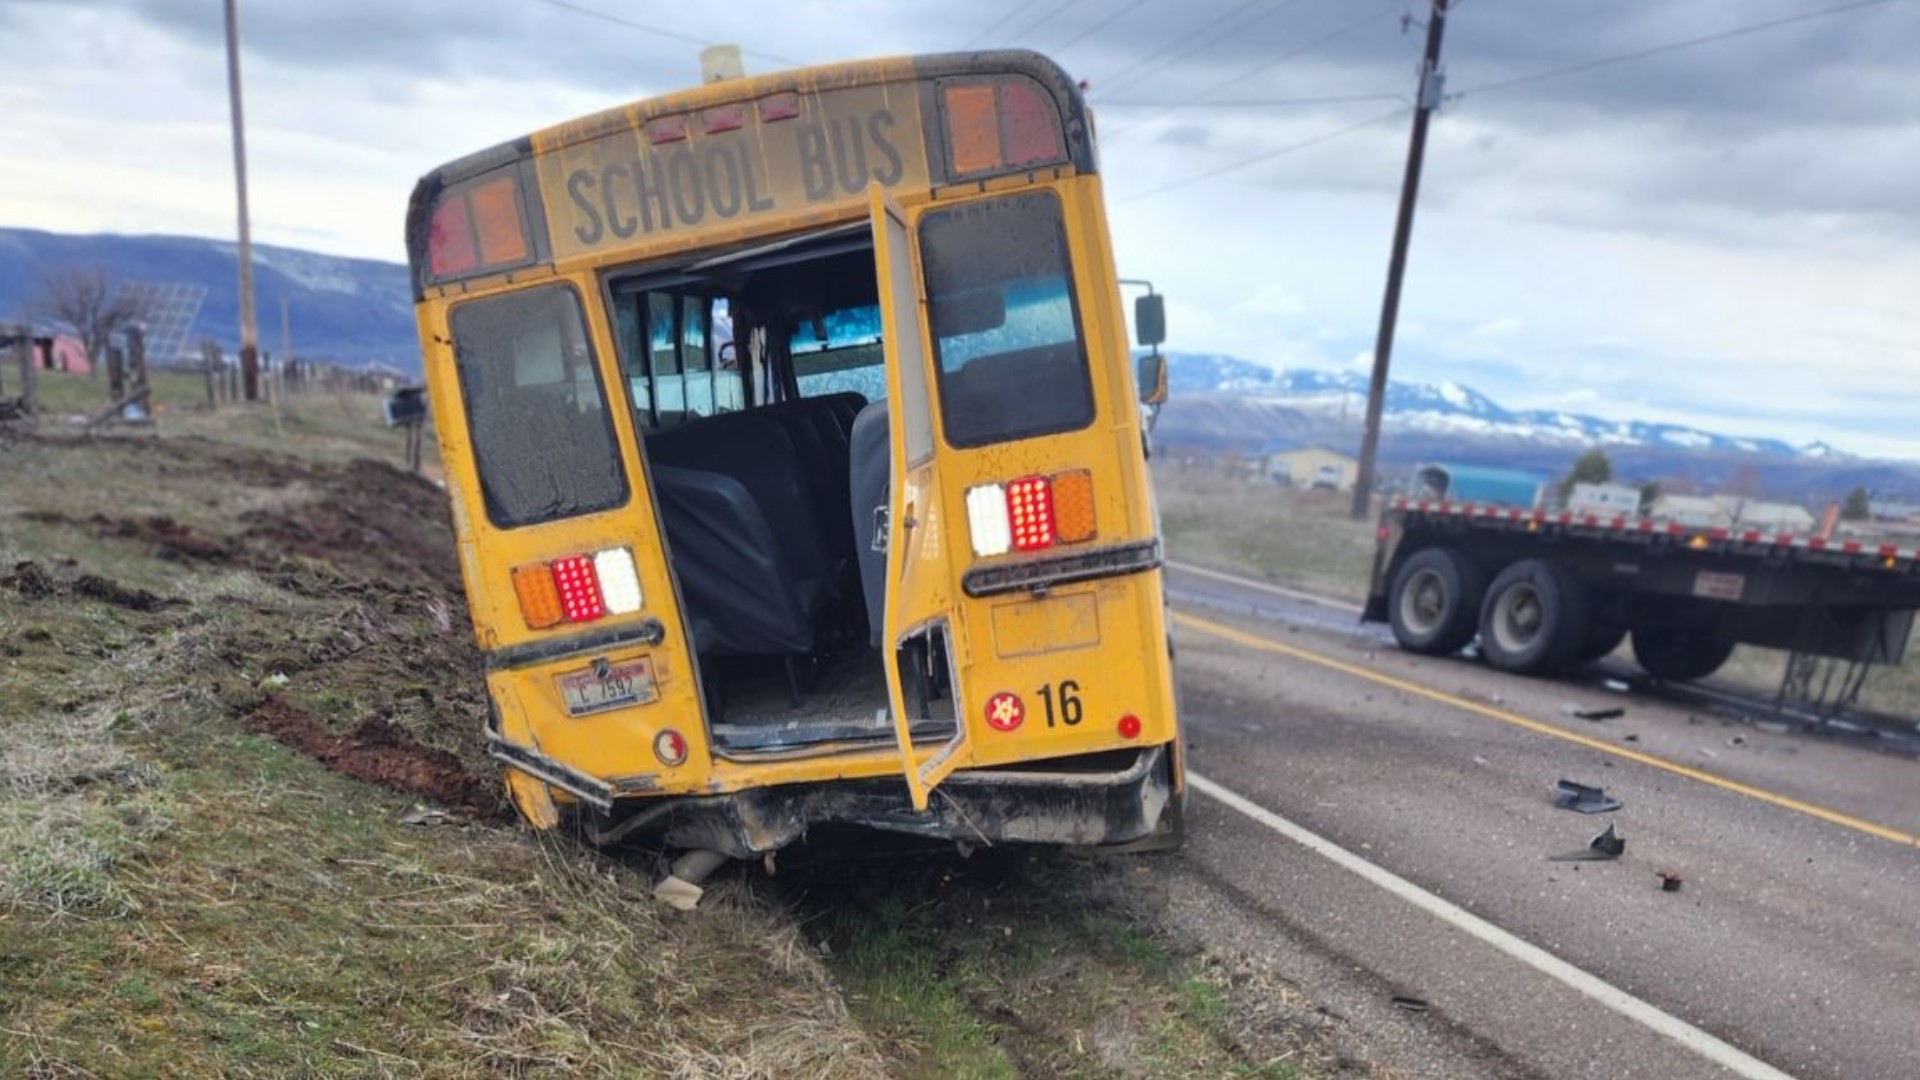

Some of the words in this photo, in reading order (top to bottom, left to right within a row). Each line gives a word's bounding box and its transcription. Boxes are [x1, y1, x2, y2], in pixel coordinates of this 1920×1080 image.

[567, 136, 774, 245] SCHOOL
[797, 109, 903, 201] BUS
[1037, 679, 1083, 728] 16
